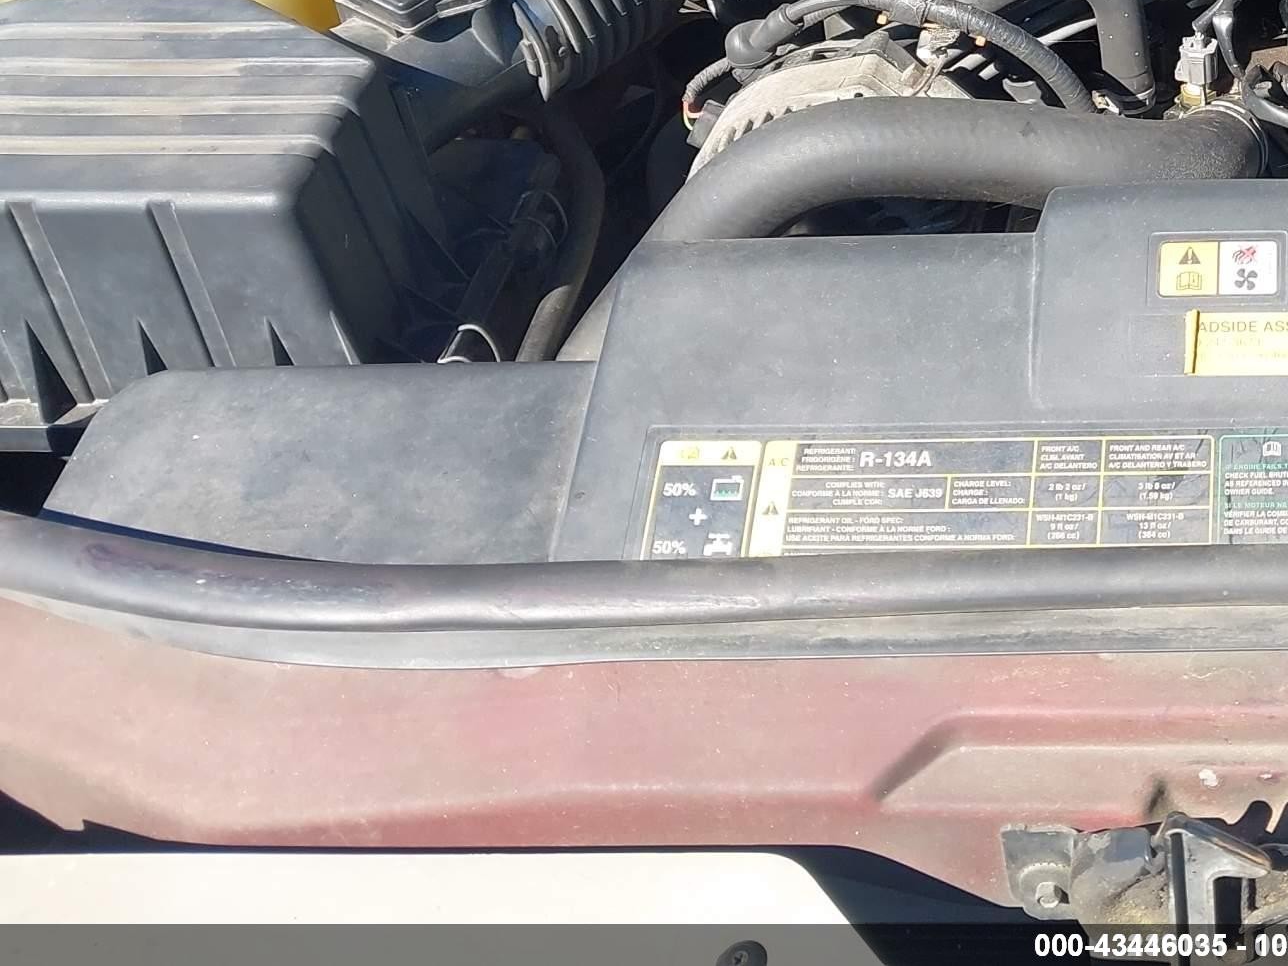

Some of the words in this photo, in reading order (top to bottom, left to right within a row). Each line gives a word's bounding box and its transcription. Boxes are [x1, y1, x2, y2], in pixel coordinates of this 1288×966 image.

[860, 450, 932, 468] R-134A
[662, 482, 697, 497] 50%
[888, 488, 912, 498] SAE
[914, 488, 943, 498] J639
[652, 540, 686, 554] 50%
